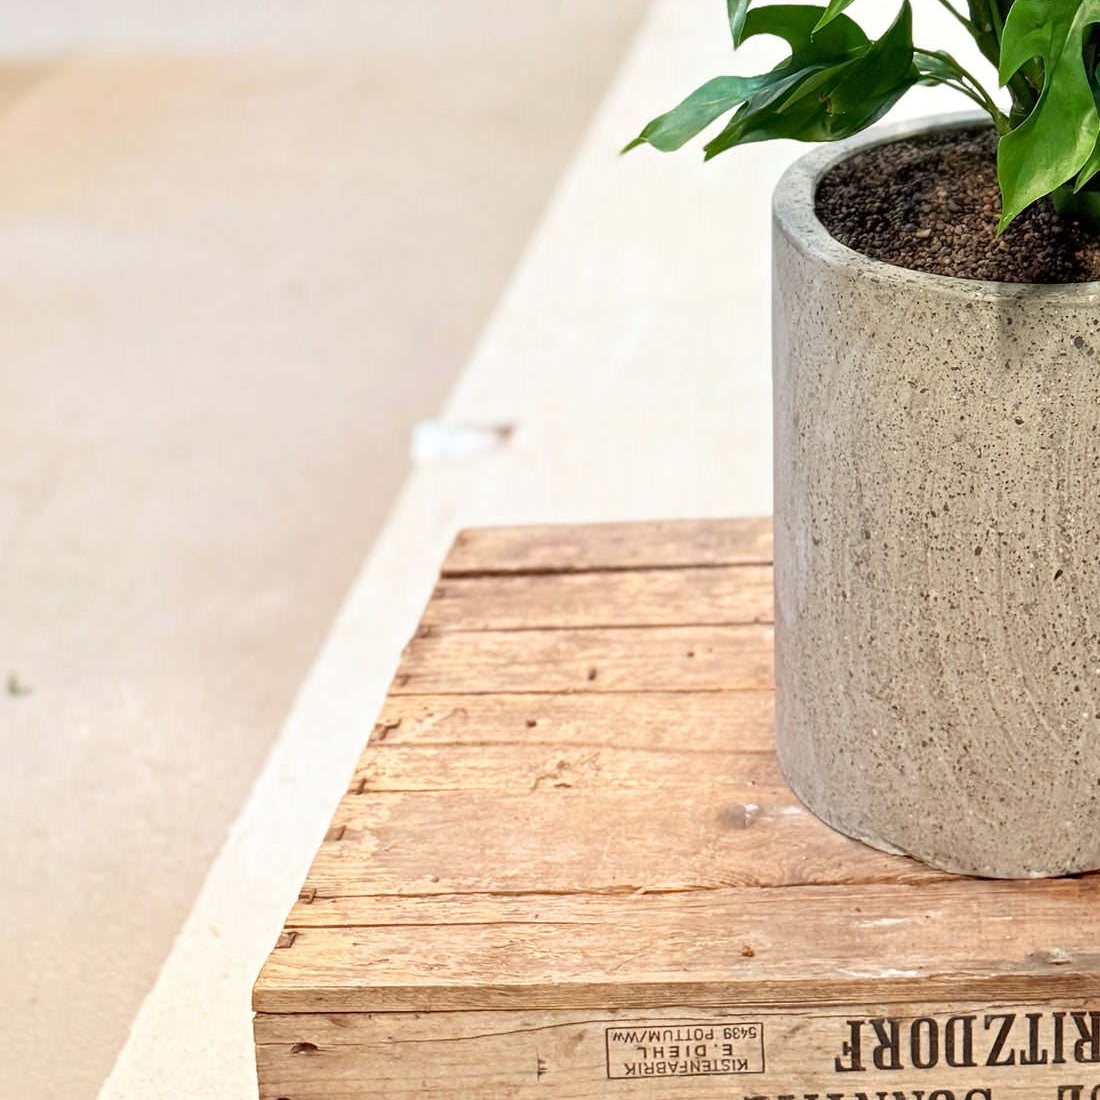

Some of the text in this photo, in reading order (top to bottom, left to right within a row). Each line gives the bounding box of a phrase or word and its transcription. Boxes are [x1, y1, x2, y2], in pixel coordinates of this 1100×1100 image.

[723, 1026, 757, 1040] 5439
[636, 1043, 734, 1059] E. DIEHL
[623, 1058, 749, 1075] KISTENFABRIK
